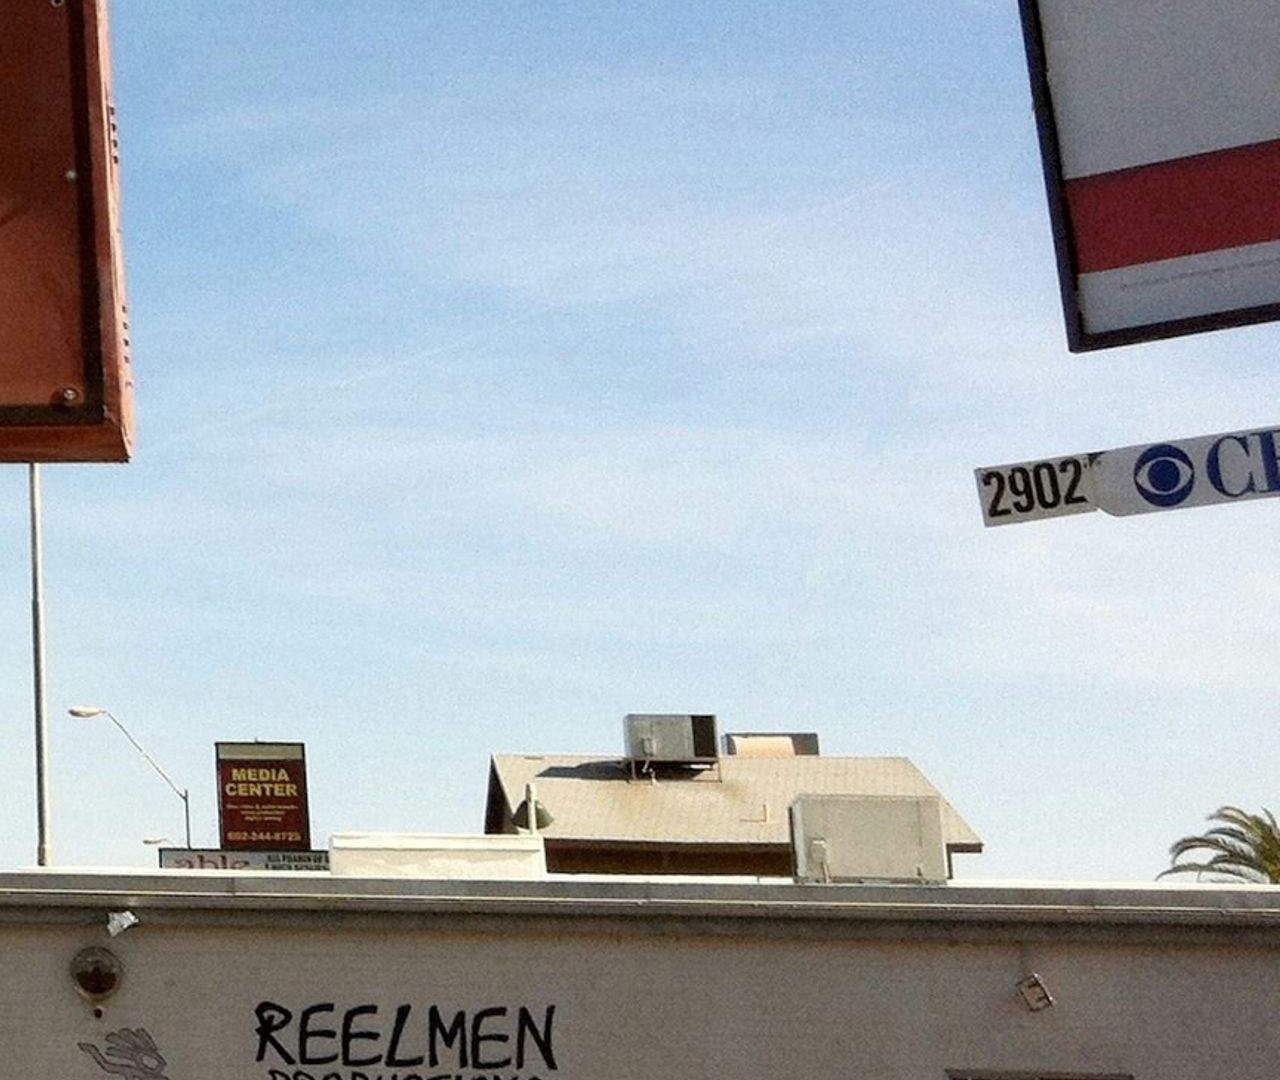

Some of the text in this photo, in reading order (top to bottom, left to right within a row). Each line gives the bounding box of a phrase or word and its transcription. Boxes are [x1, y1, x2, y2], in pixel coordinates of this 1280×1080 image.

[981, 458, 1089, 518] 2902
[224, 783, 299, 797] CENTER
[231, 768, 291, 781] MEDIA
[254, 1000, 558, 1071] REELMEN
